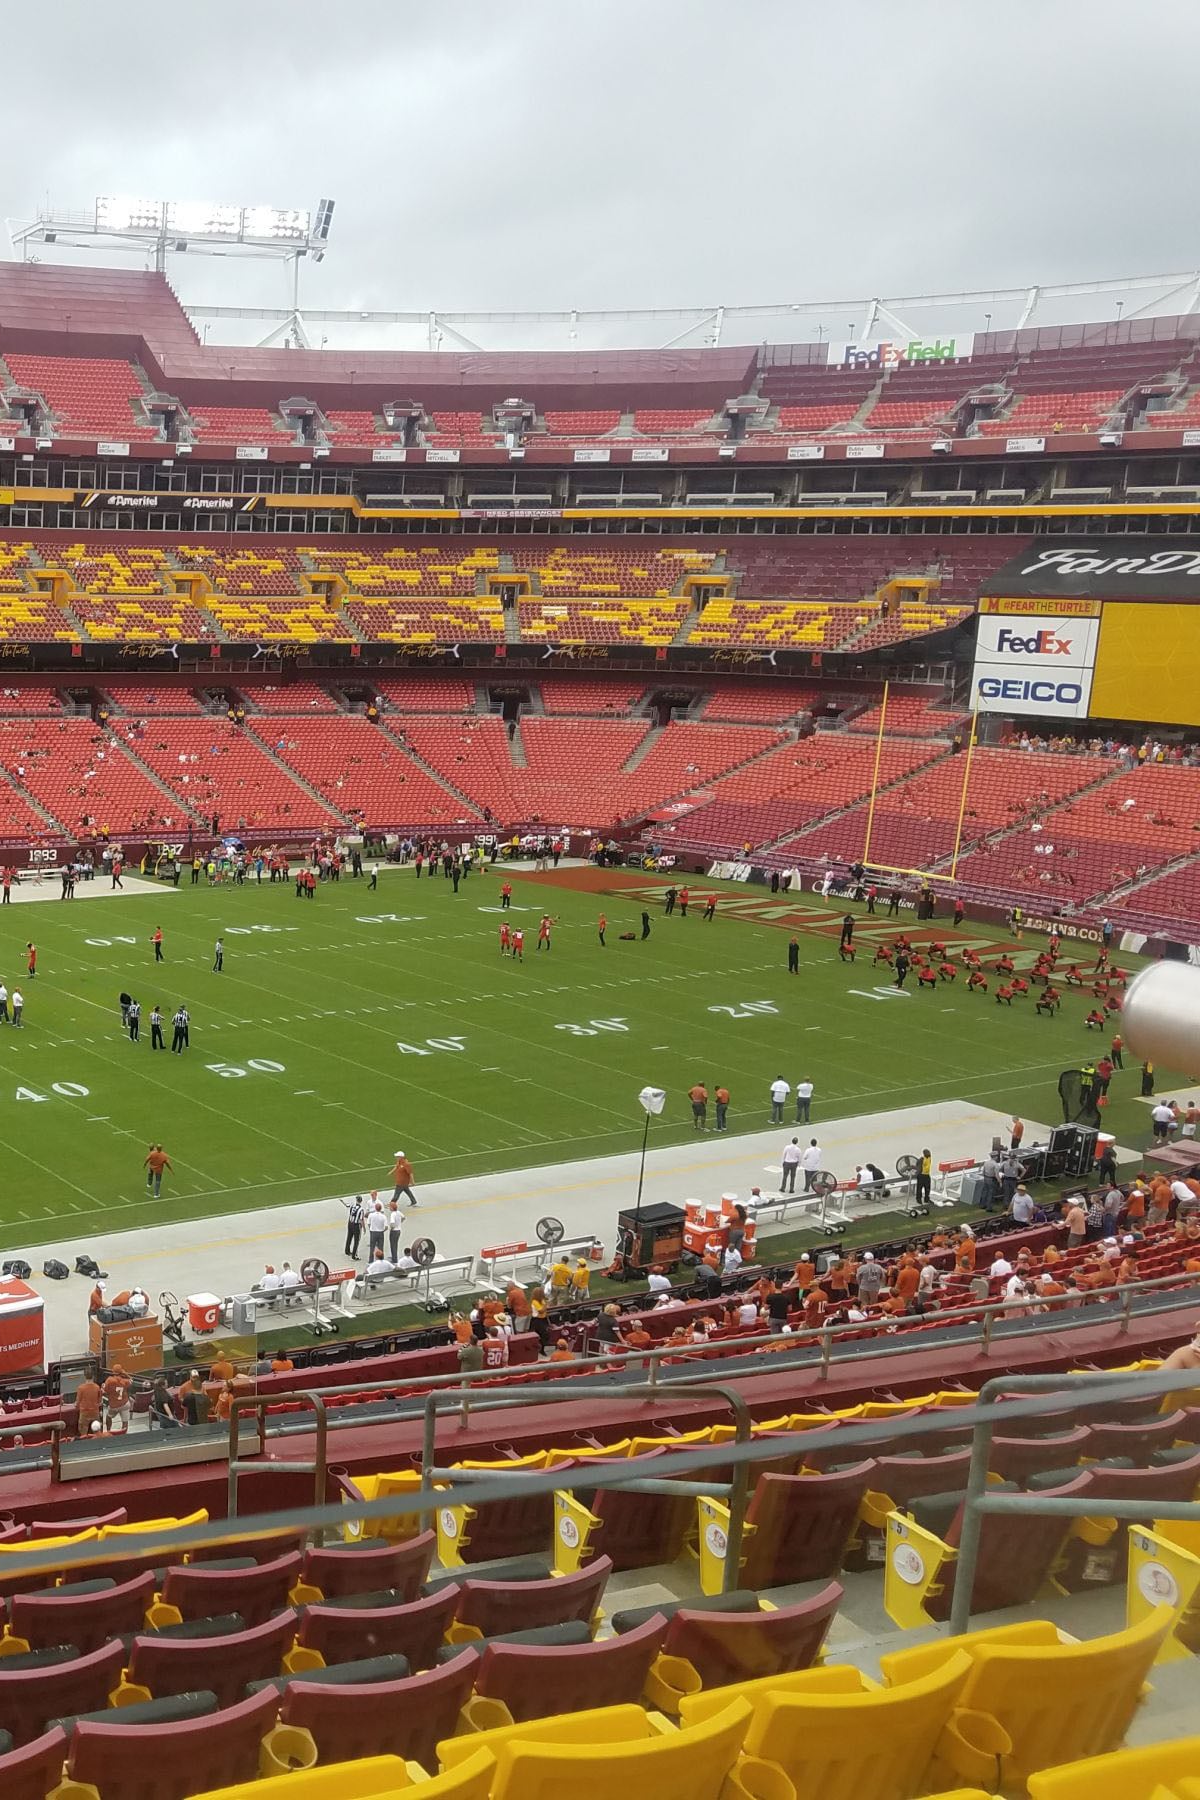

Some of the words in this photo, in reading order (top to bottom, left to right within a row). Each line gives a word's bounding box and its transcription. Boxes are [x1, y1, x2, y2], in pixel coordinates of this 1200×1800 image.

[845, 339, 956, 363] FedExField
[1021, 549, 1200, 575] FanD
[997, 629, 1073, 655] FedEx
[978, 677, 1083, 704] GEICO
[848, 984, 912, 1001] 10
[706, 1000, 780, 1019] 20
[554, 1017, 631, 1037] 30
[396, 1036, 467, 1057] 40
[204, 1057, 287, 1079] 50
[13, 1081, 91, 1103] 40
